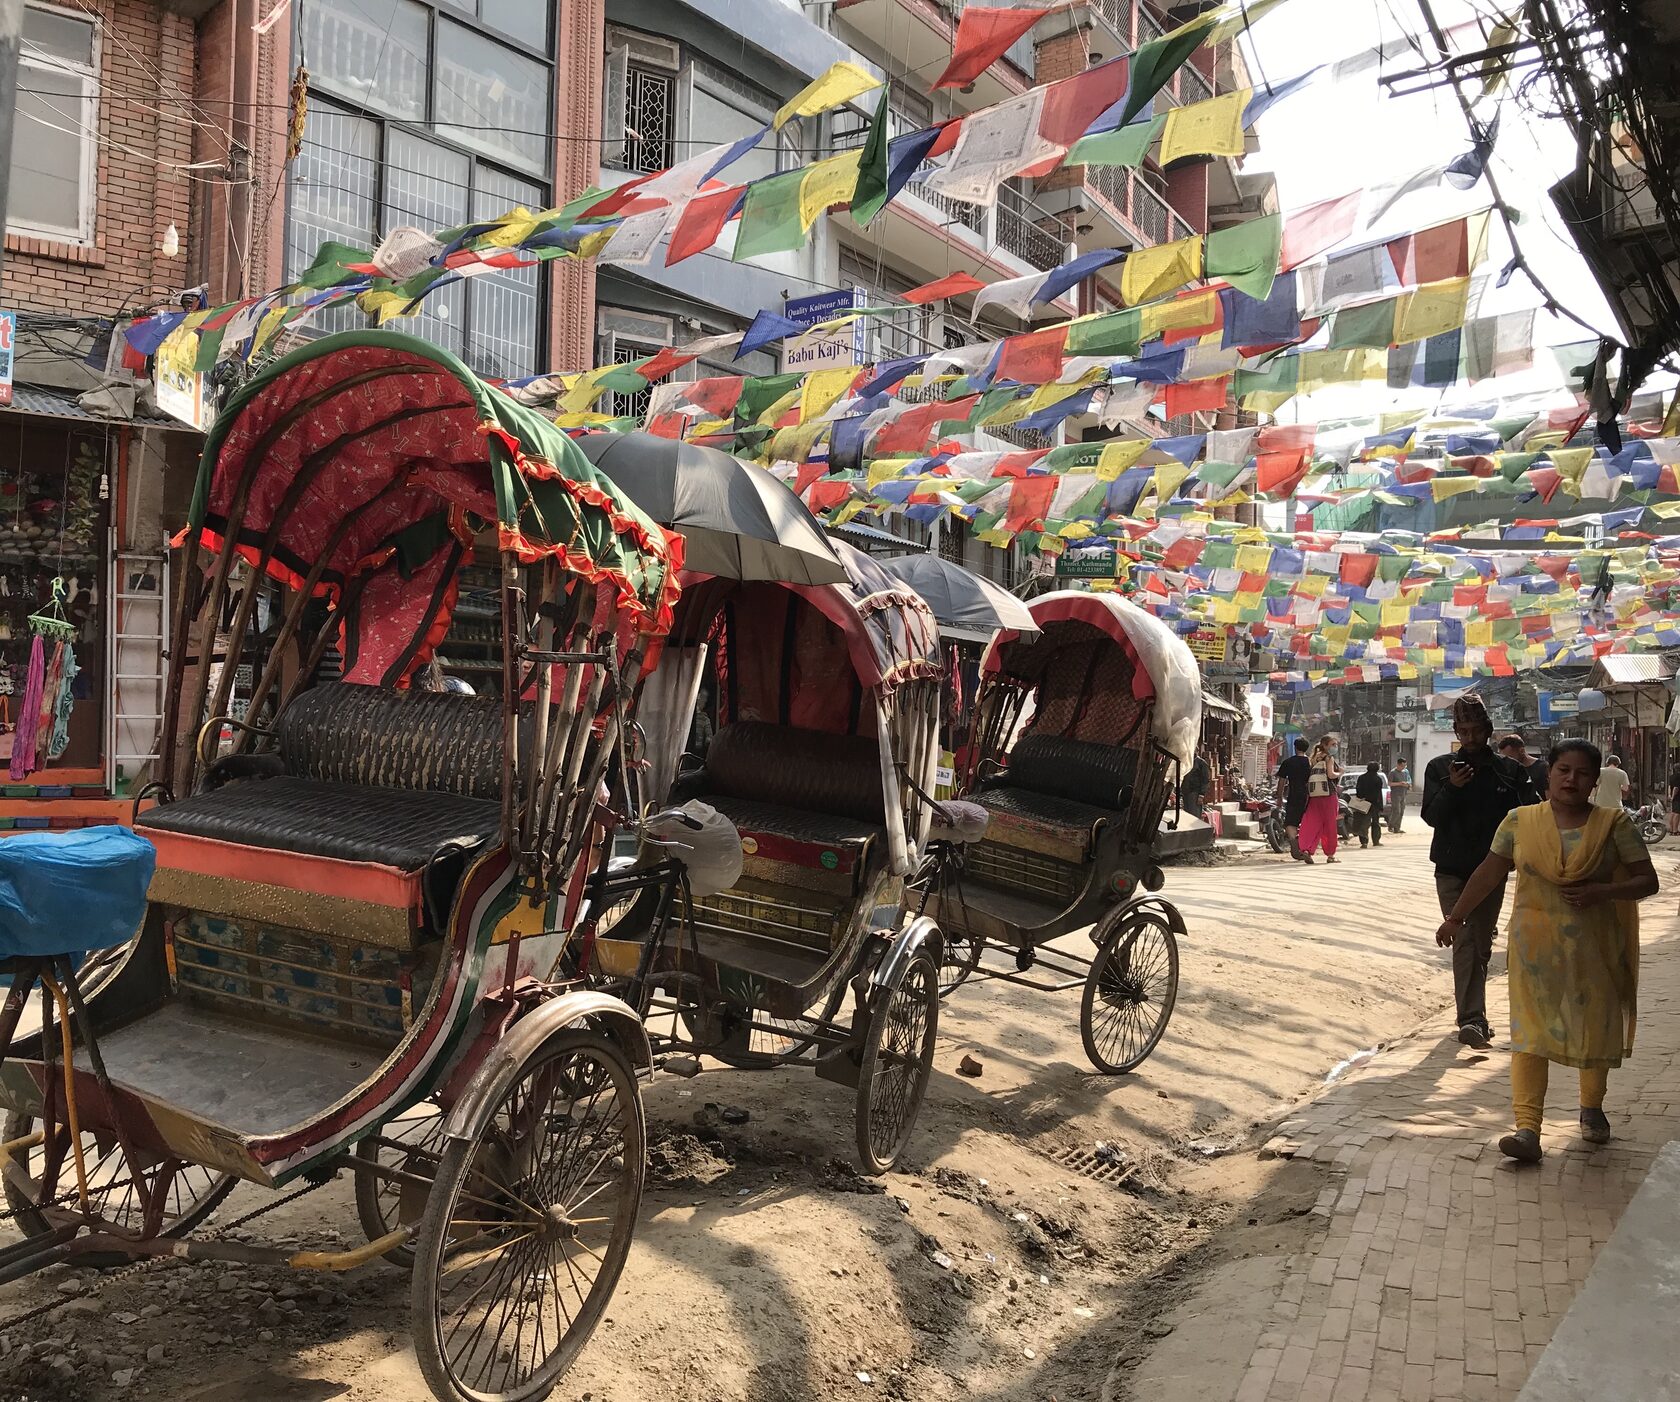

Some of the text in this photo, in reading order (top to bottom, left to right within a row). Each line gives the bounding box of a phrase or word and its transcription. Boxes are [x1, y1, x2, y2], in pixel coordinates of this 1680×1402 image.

[788, 297, 850, 319] Quality Knitwear Mfr.
[817, 312, 842, 323] Decades
[788, 339, 849, 364] Babu Kaji's
